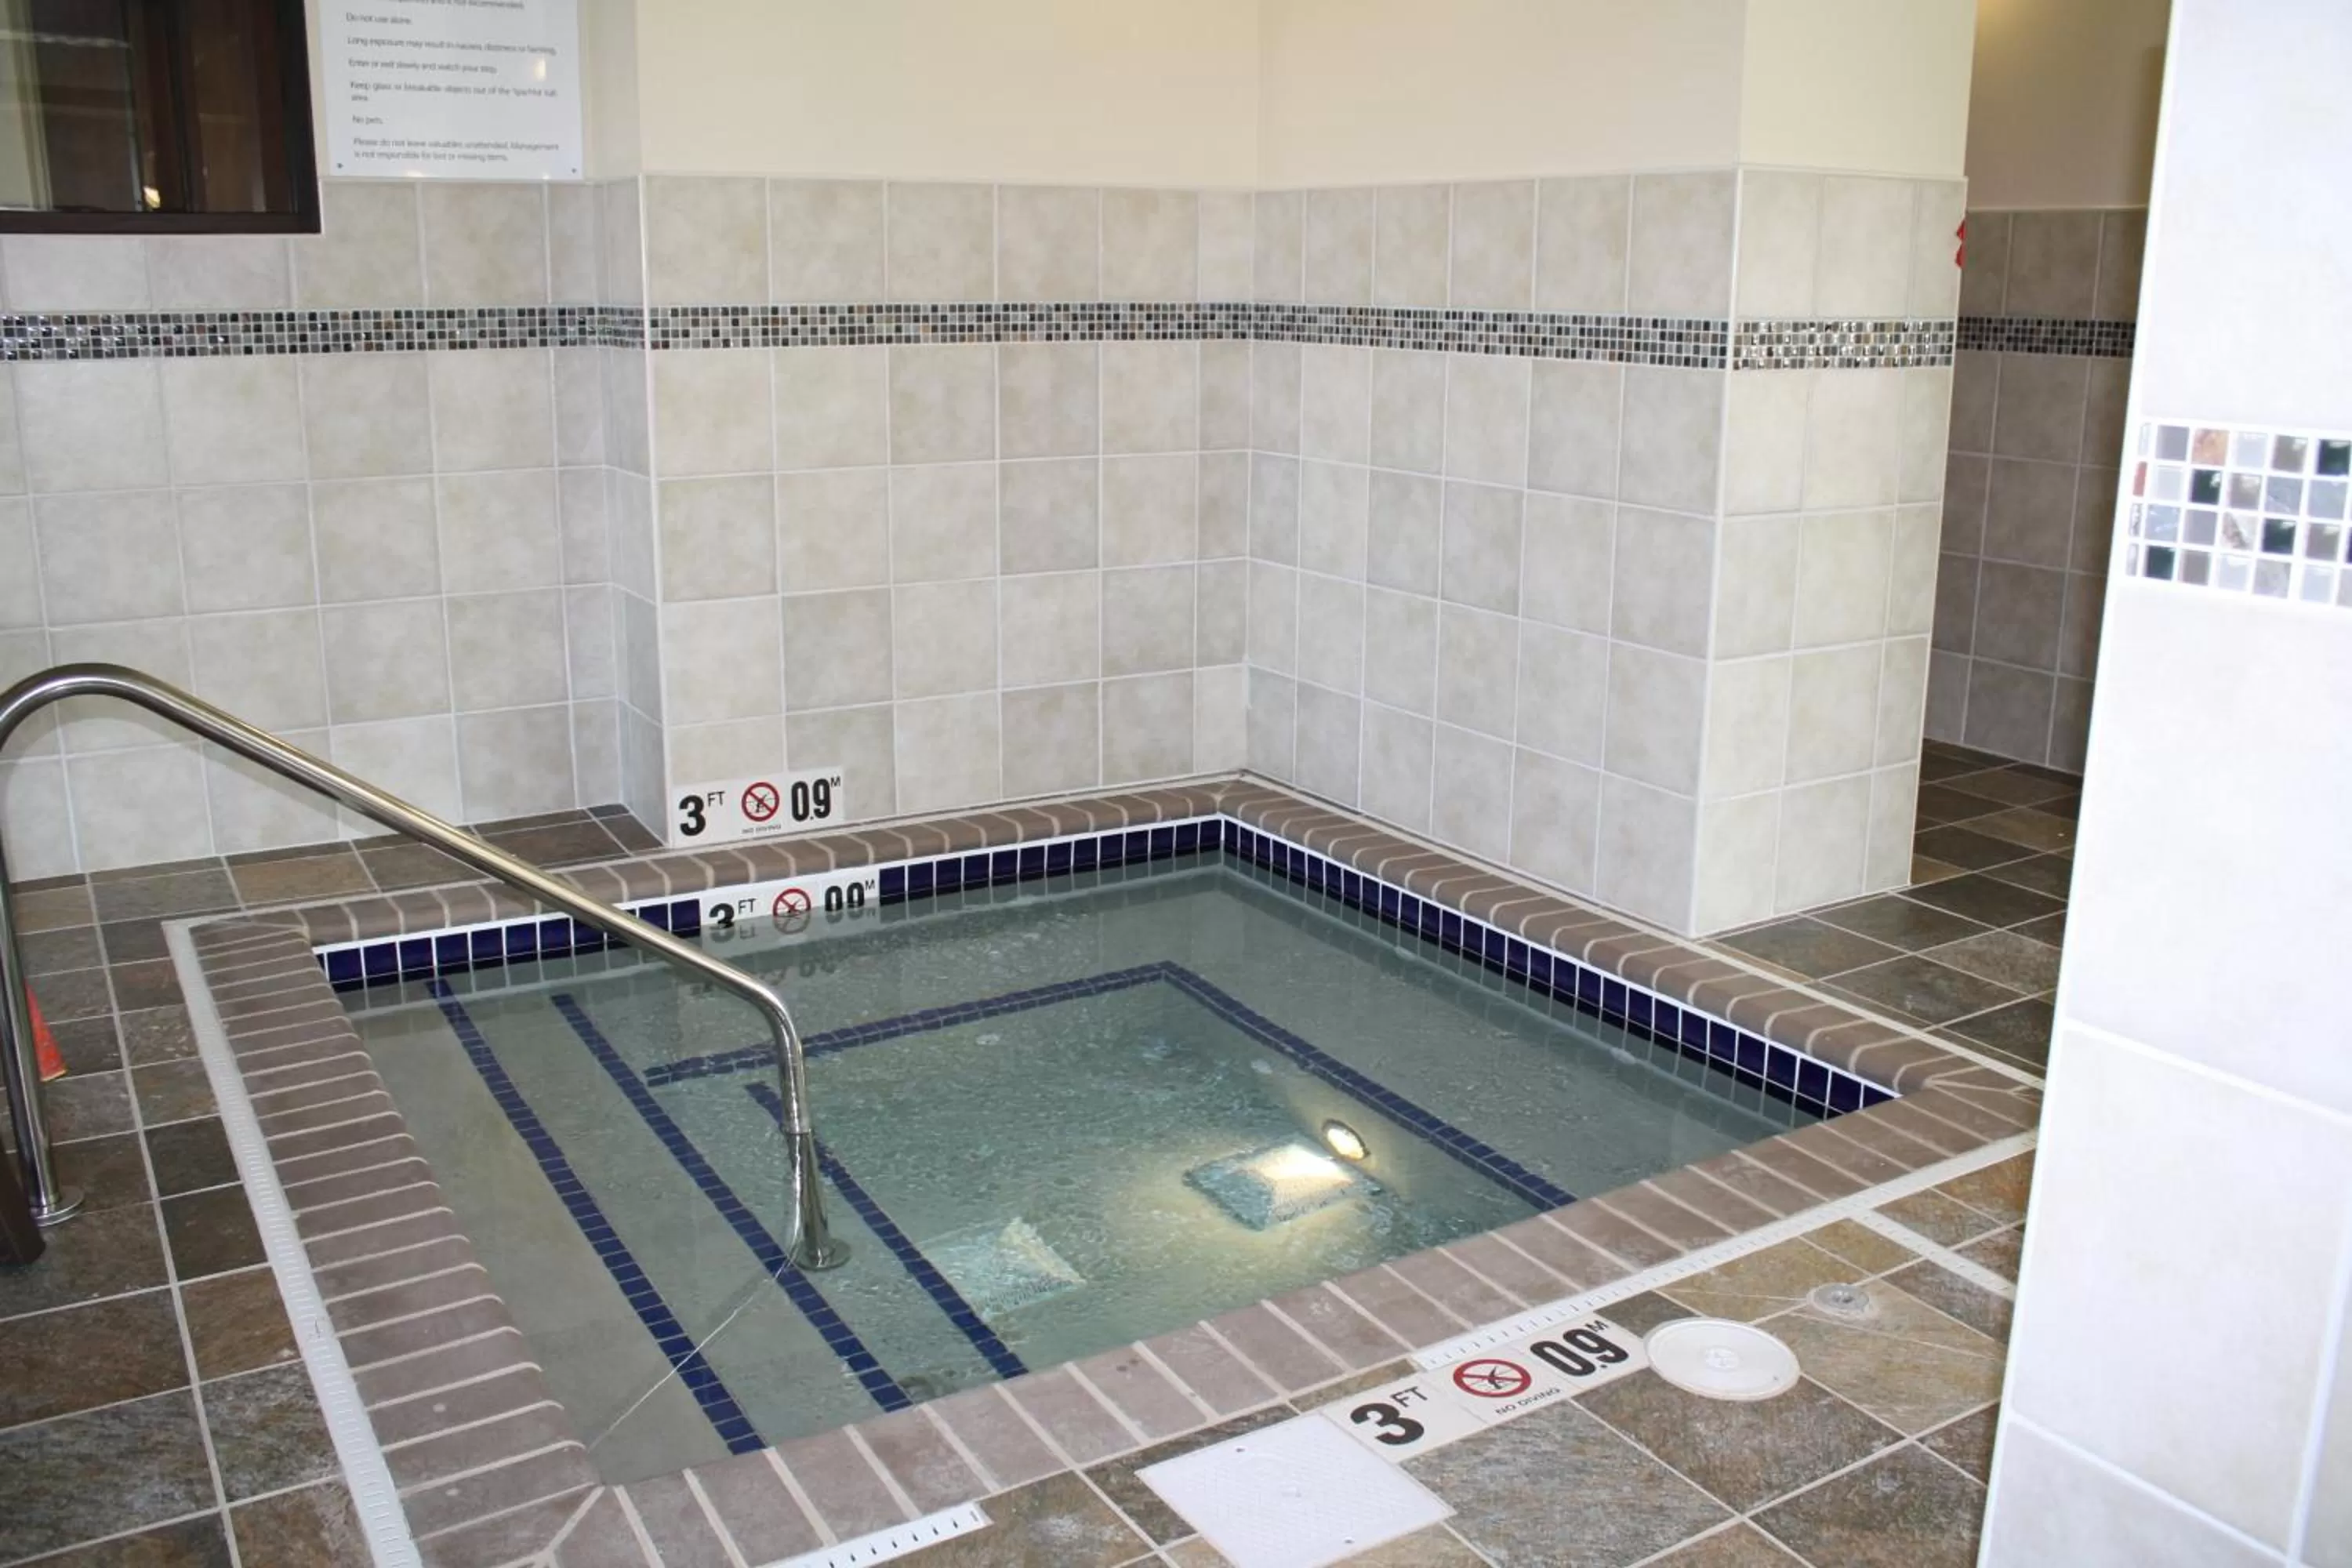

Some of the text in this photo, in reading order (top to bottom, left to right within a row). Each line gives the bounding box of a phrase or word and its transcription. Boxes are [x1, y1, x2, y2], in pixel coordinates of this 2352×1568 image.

[679, 790, 725, 837] 3 FT
[791, 776, 841, 822] 0.9 M
[738, 898, 757, 915] FT
[865, 879, 876, 891] M
[1530, 1319, 1629, 1377] 0.9 M
[1350, 1386, 1428, 1446] 3 FT
[1495, 1404, 1516, 1414] NO
